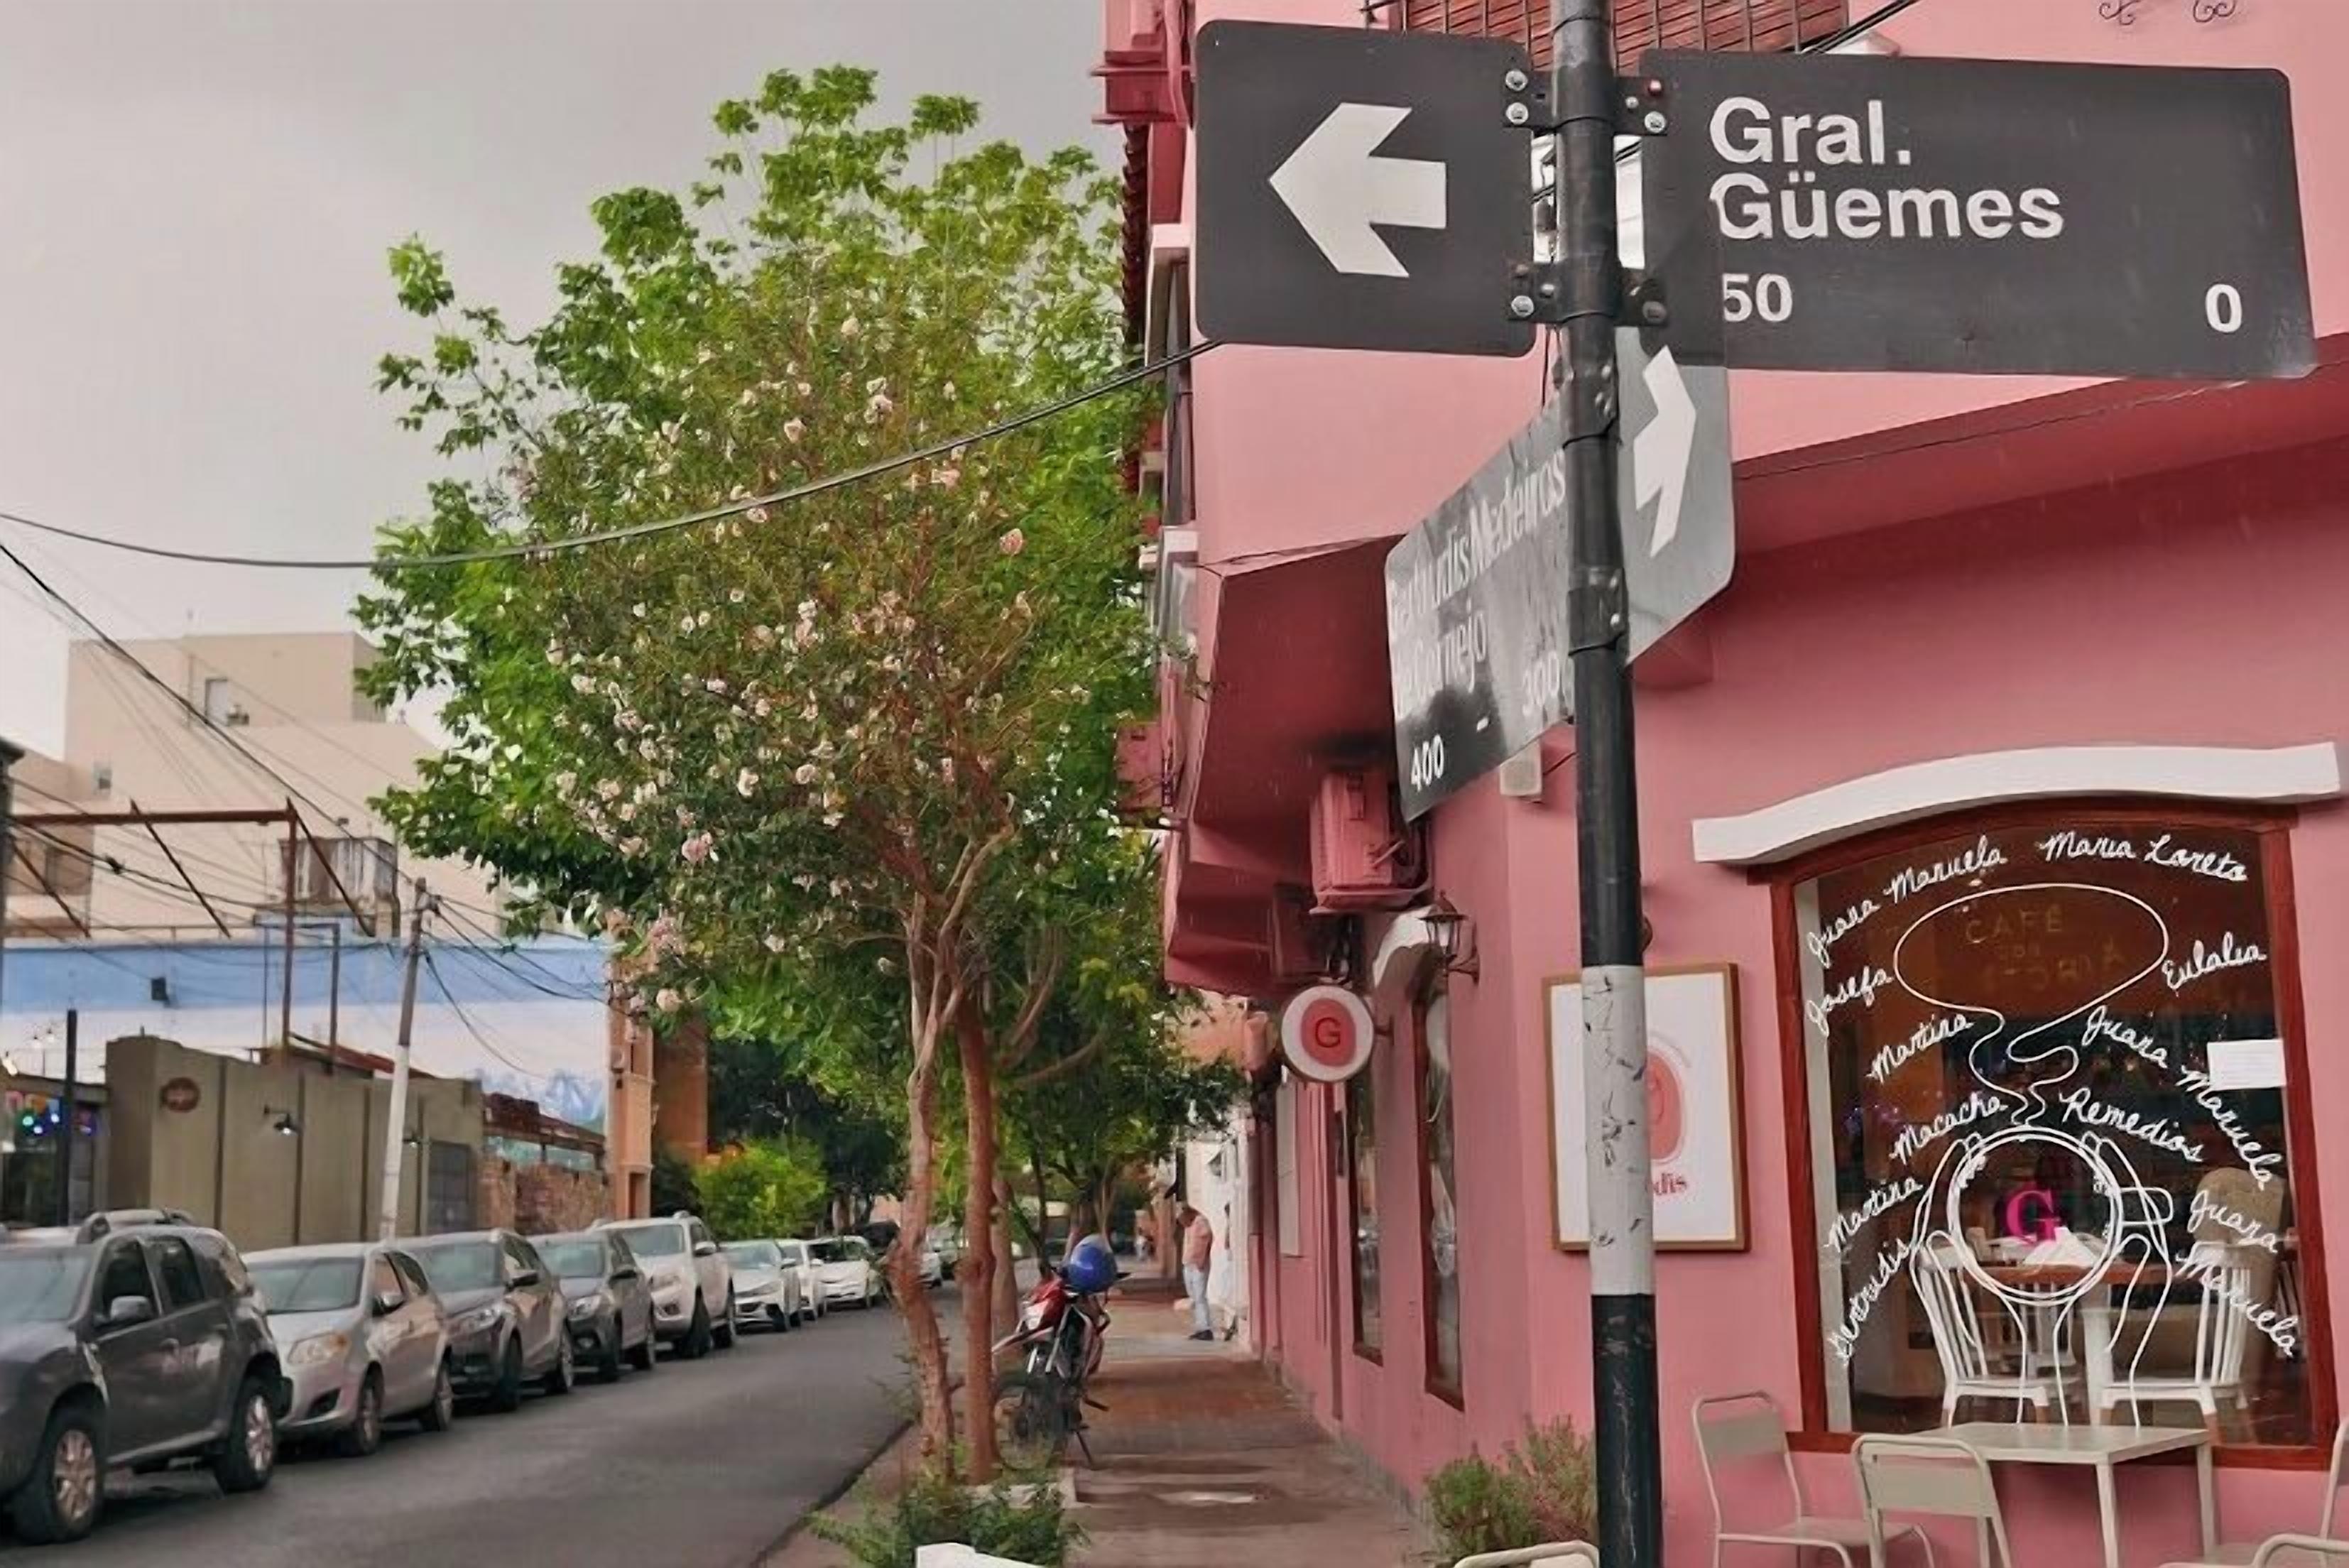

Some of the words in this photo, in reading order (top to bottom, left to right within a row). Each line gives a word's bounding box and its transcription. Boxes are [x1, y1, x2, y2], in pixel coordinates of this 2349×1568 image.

[1709, 97, 1911, 165] Gral.
[1709, 170, 2065, 239] Güemes
[1722, 273, 1794, 322] 50
[2204, 283, 2243, 332] 0
[1410, 734, 1444, 793] 400
[1883, 834, 2008, 903] Manuela
[1315, 1017, 1341, 1048] G
[1807, 966, 1895, 1038] Josefa
[1865, 1013, 1975, 1084] Martina
[2081, 1006, 2167, 1069] Juana
[1889, 1091, 2008, 1165] Macacha
[2059, 1087, 2203, 1162] Remedios
[2007, 1189, 2061, 1246] G
[2187, 1189, 2278, 1253] Juana
